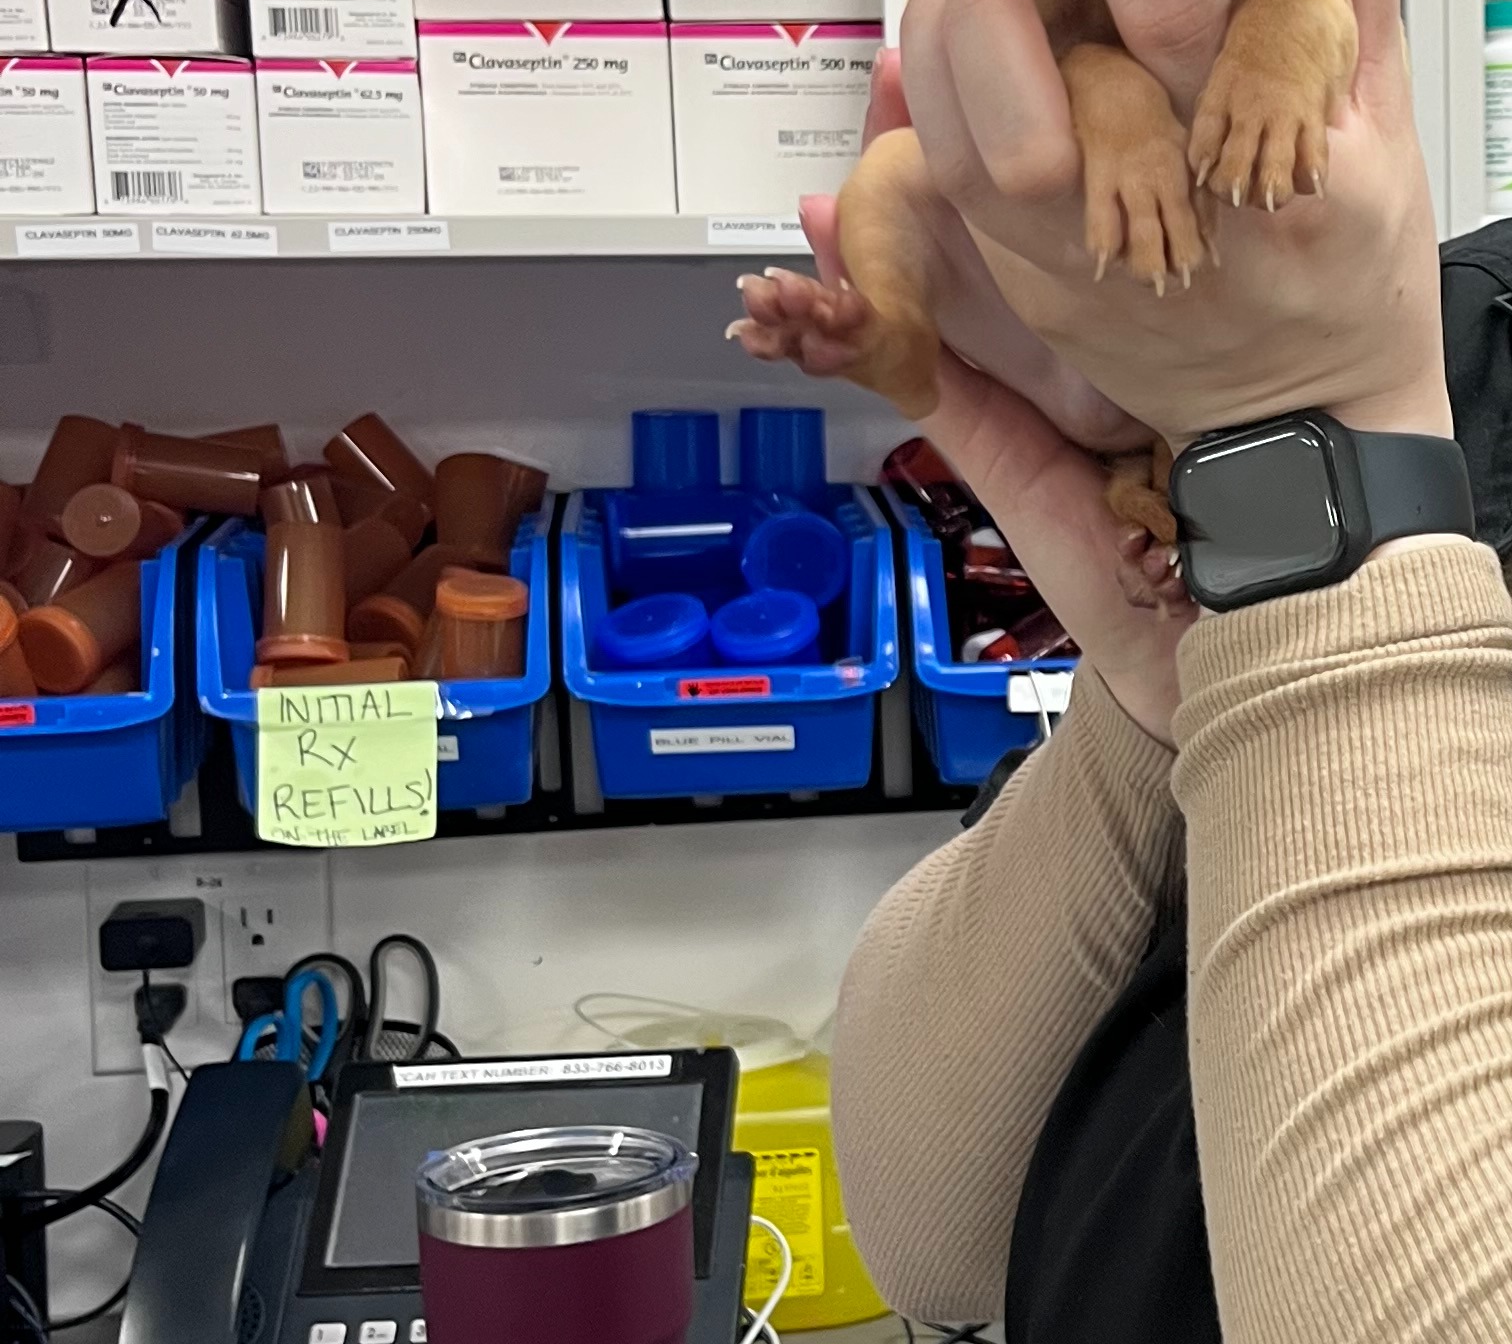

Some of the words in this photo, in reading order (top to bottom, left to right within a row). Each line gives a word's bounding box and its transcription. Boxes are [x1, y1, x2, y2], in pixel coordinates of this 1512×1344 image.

[469, 53, 563, 72] Clavaseptin
[572, 56, 599, 71] 250
[603, 57, 629, 74] mg
[719, 54, 812, 73] Clavaseptin
[819, 57, 845, 72] 500
[849, 59, 873, 74] mg
[40, 88, 60, 100] mg
[114, 83, 185, 99] Clavaseptin
[210, 88, 230, 100] mg
[283, 86, 352, 101] Clavaseptin
[156, 226, 227, 239] CLAVASEPTIN
[334, 226, 402, 236] CLAVASEPTIN
[712, 222, 776, 231] CLAVASEPTIN
[25, 228, 97, 240] CLAVASEPTIN
[654, 735, 699, 748] BLUE
[709, 734, 745, 746] PILL
[754, 733, 791, 744] VIAL
[441, 1067, 481, 1081] TEXT
